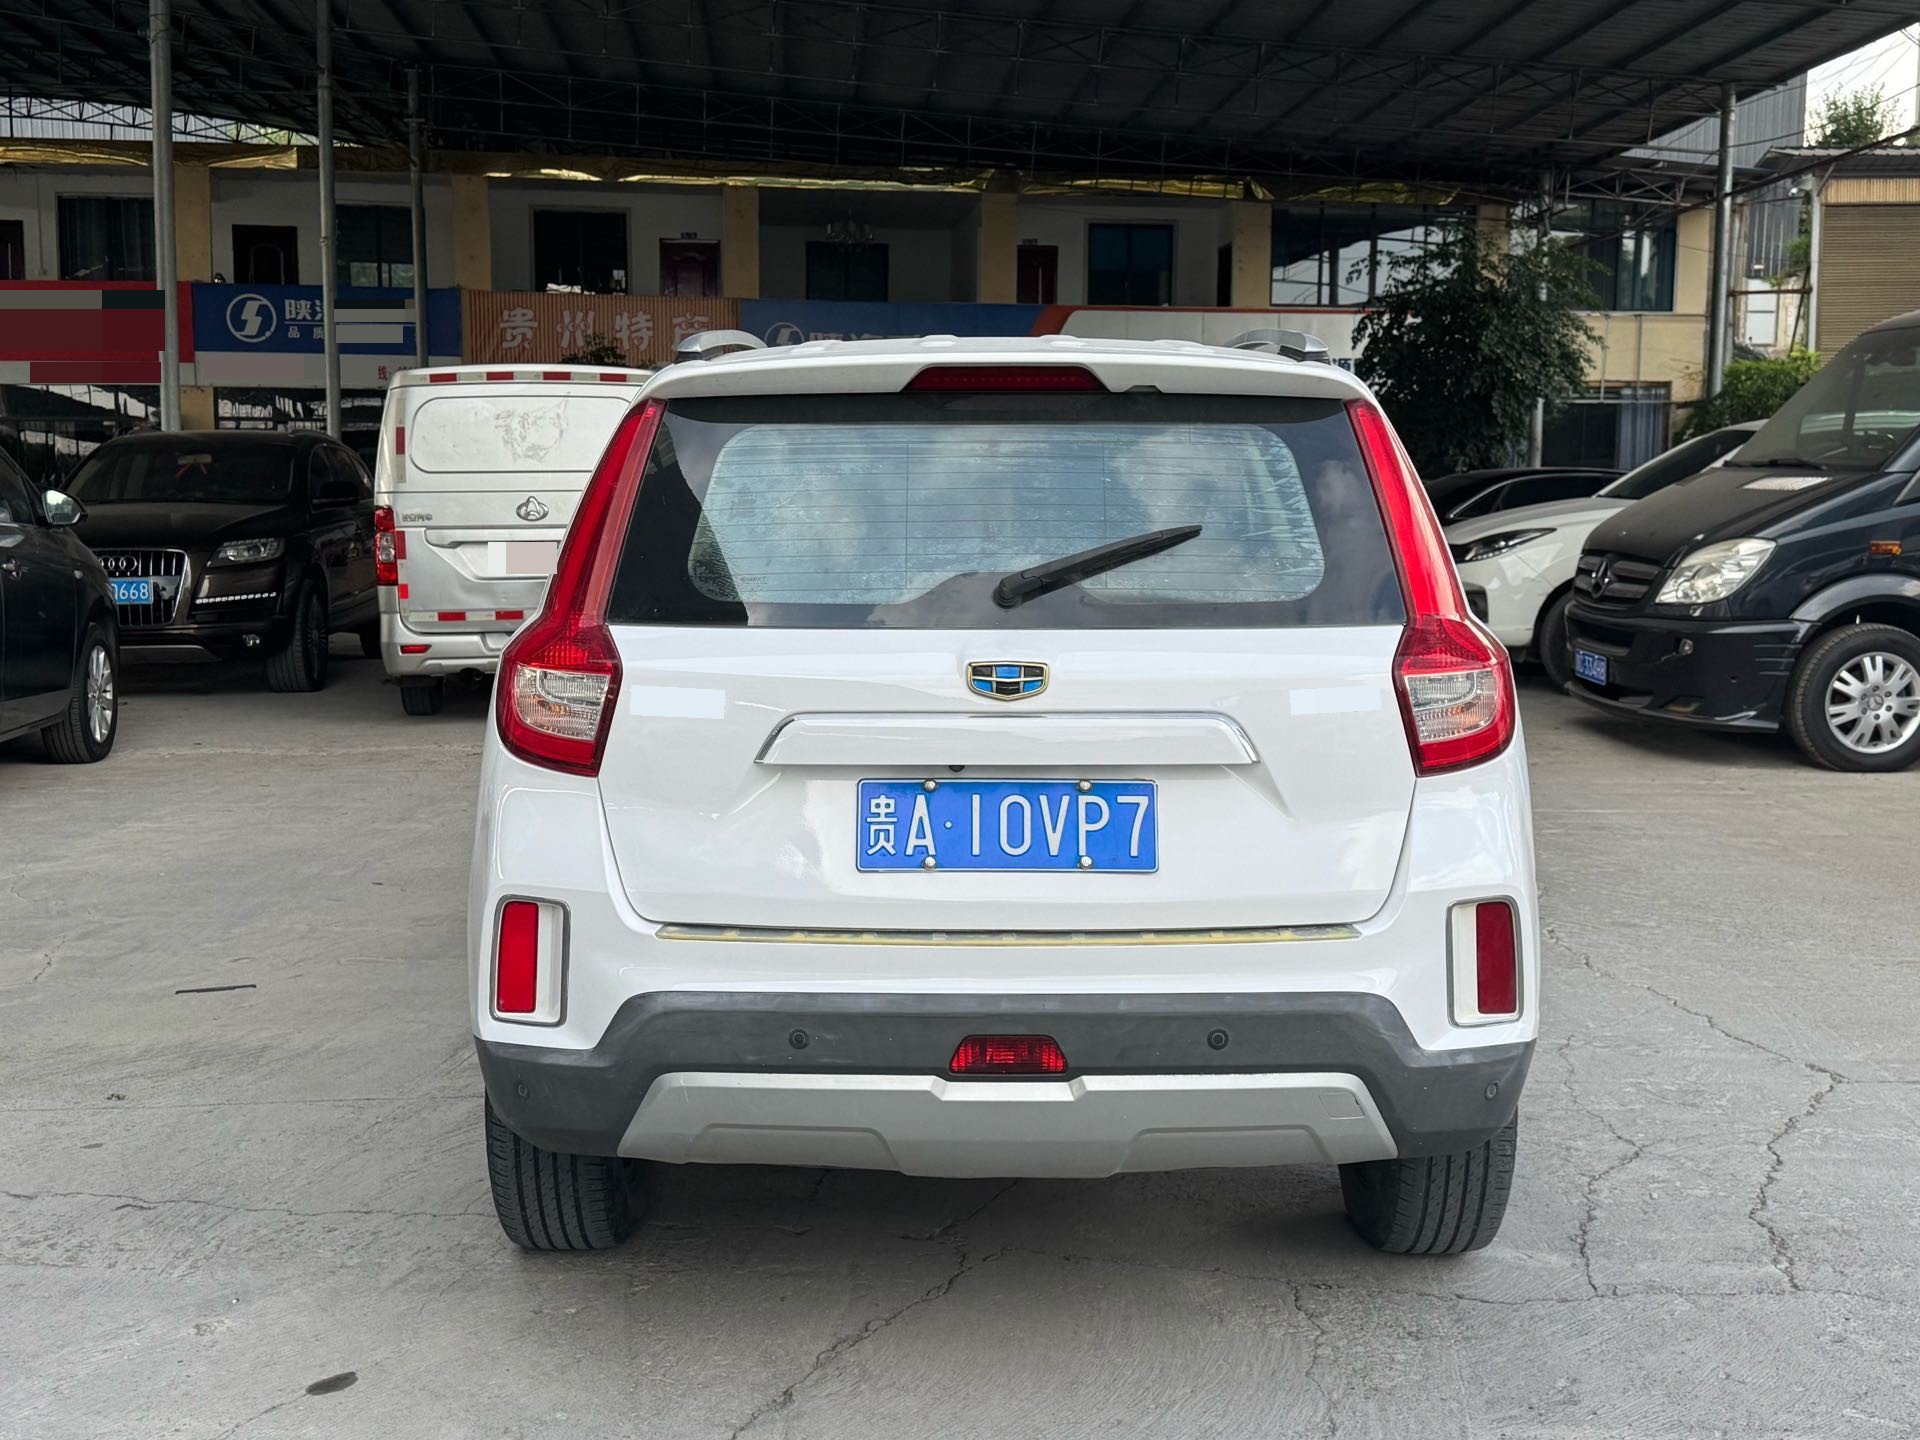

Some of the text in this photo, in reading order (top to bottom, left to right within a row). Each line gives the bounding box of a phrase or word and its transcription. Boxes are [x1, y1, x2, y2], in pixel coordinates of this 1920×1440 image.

[500, 306, 709, 351] 贵州特产
[866, 793, 1150, 857] 贵A·10VP7
